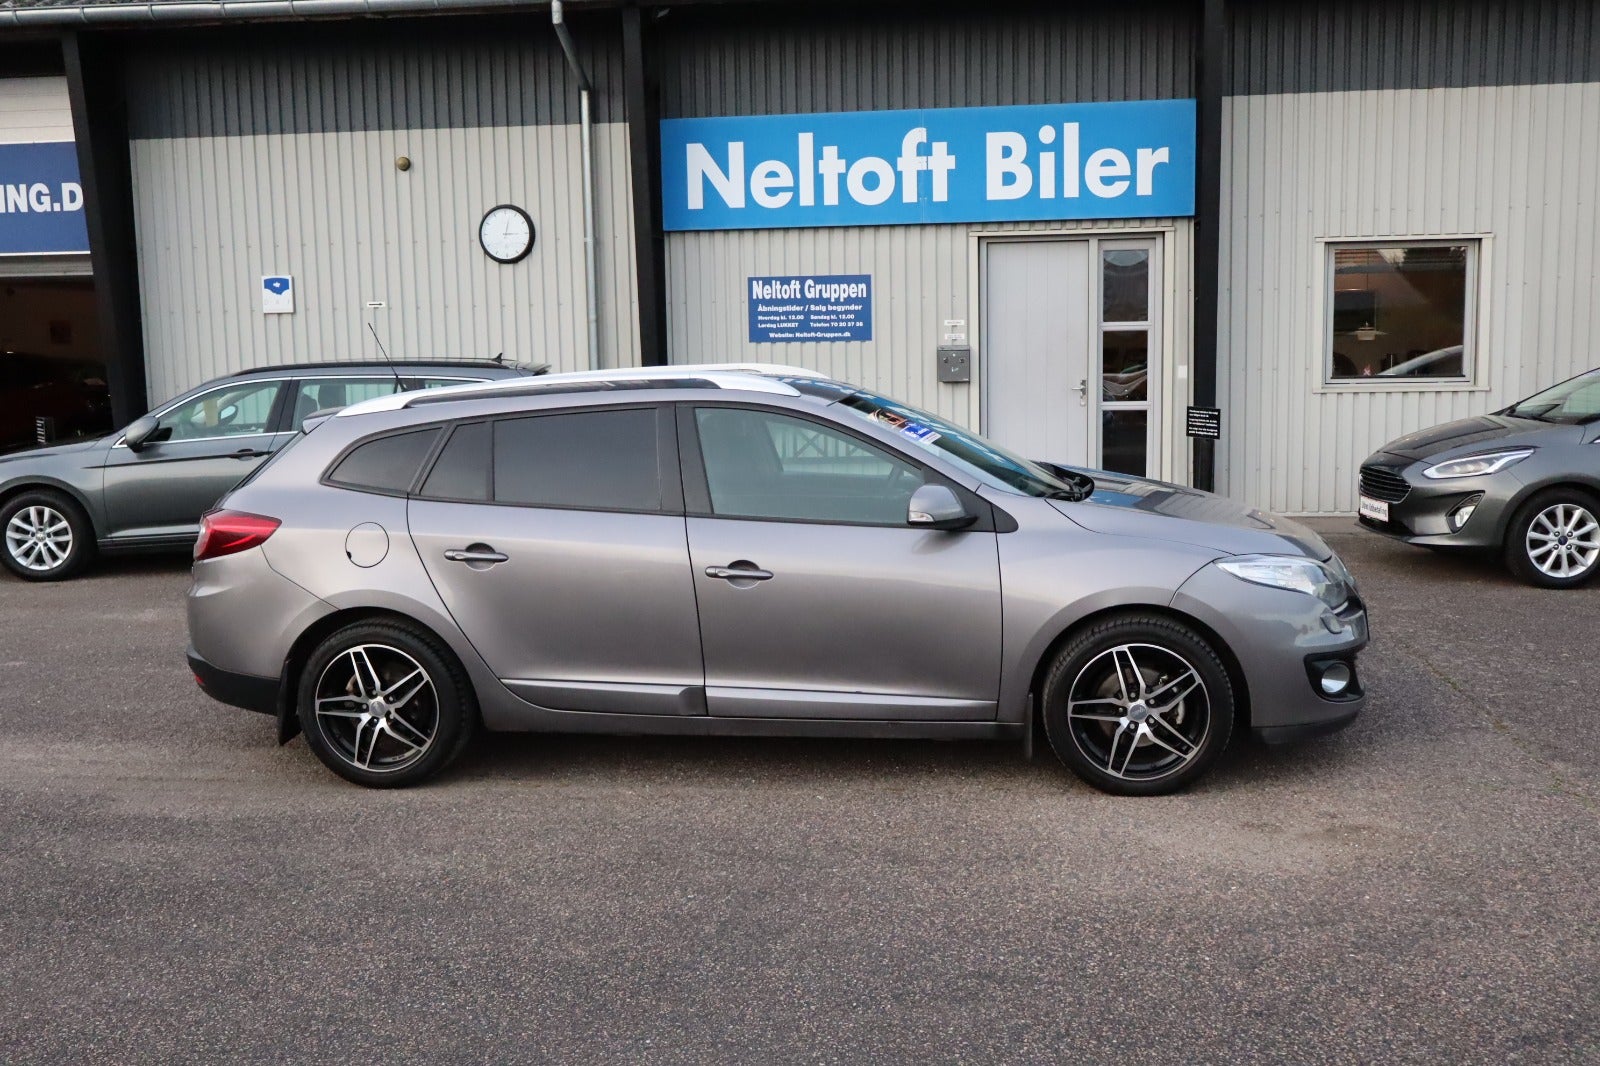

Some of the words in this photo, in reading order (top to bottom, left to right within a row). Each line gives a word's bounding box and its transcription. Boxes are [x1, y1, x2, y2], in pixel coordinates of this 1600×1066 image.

[686, 126, 956, 210] Neltoft
[986, 122, 1170, 201] Biler
[752, 279, 801, 299] Neltoft
[804, 279, 867, 302] Gruppen
[757, 303, 804, 312] Åbningstider
[810, 304, 827, 312] Salg
[827, 303, 863, 311] begynder
